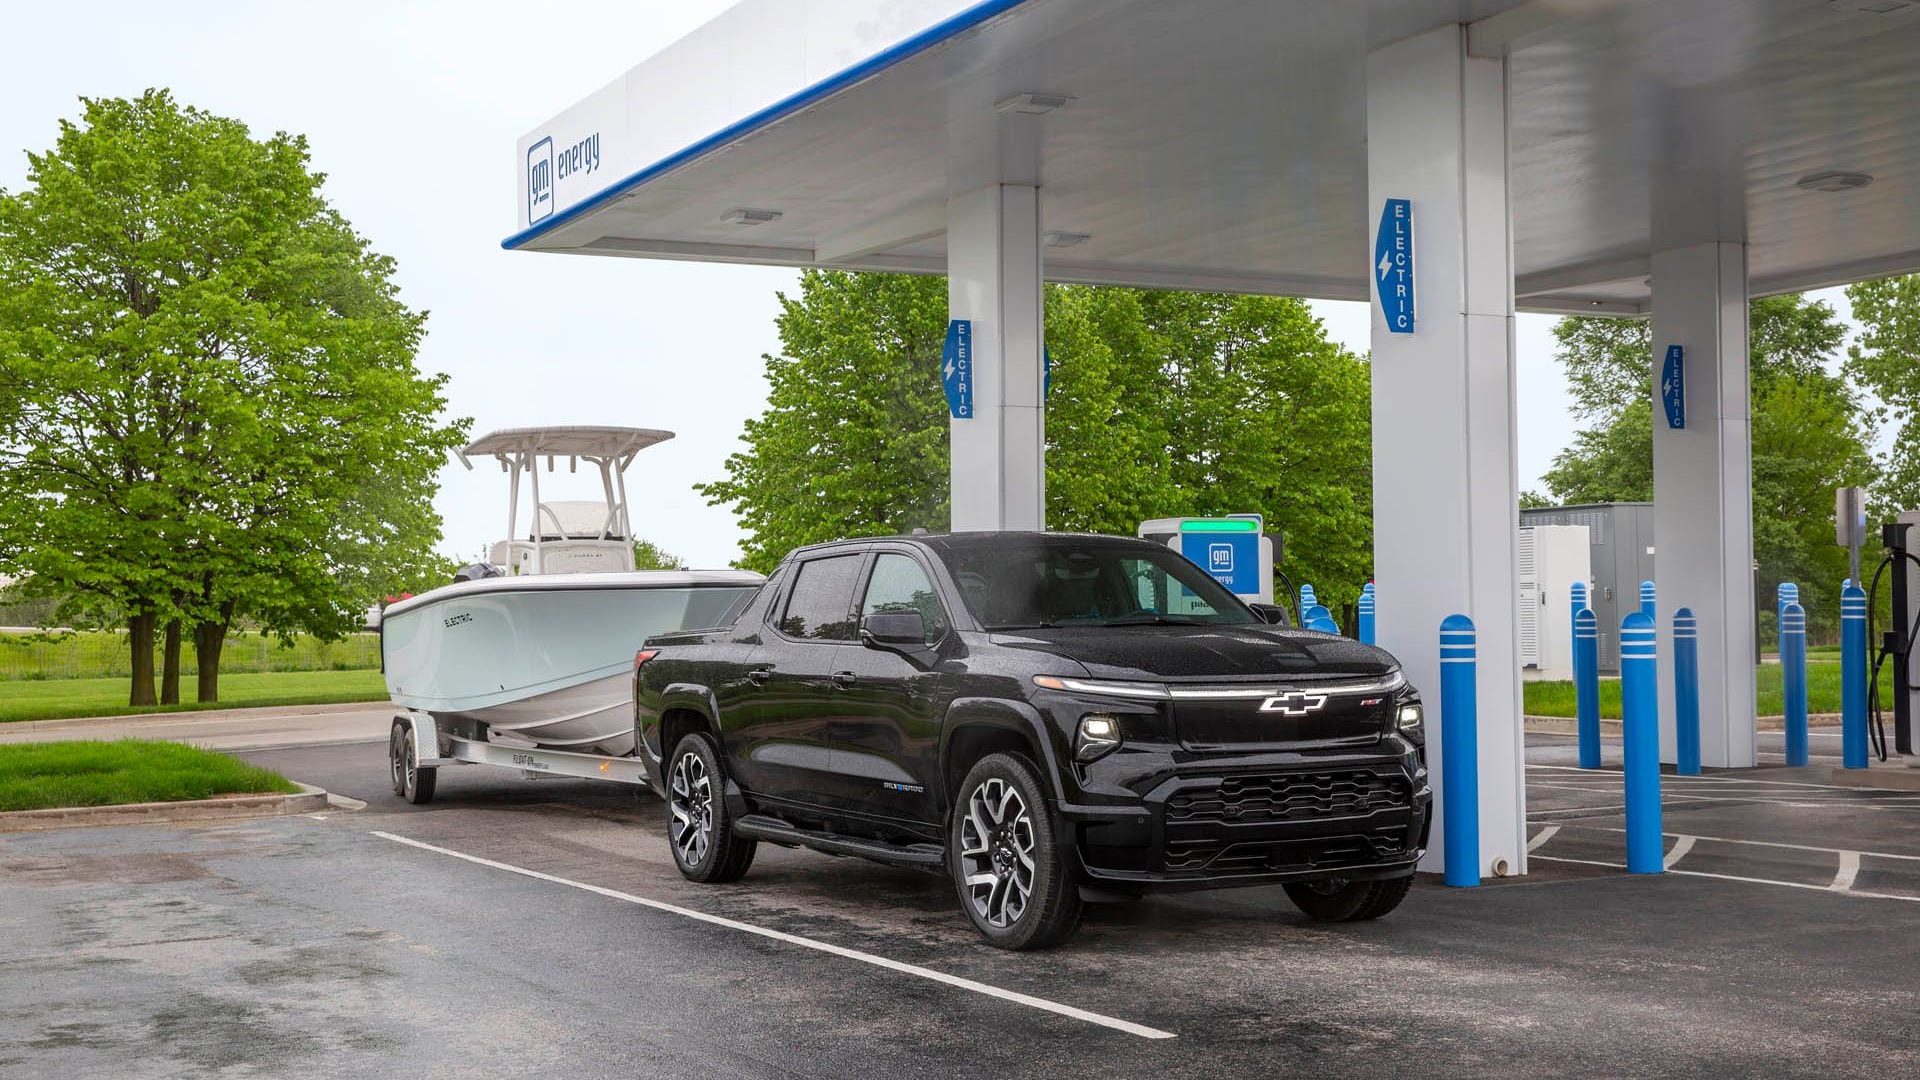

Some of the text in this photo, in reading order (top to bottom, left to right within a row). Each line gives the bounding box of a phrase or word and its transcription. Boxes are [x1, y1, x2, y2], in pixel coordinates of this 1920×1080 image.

[532, 132, 600, 206] gm energy
[1395, 204, 1408, 328] ELECTRIC
[958, 324, 968, 415] ELECTRIC
[1673, 348, 1681, 426] ELECTRIC
[1213, 550, 1230, 565] gm
[444, 613, 473, 628] ELECTRIC
